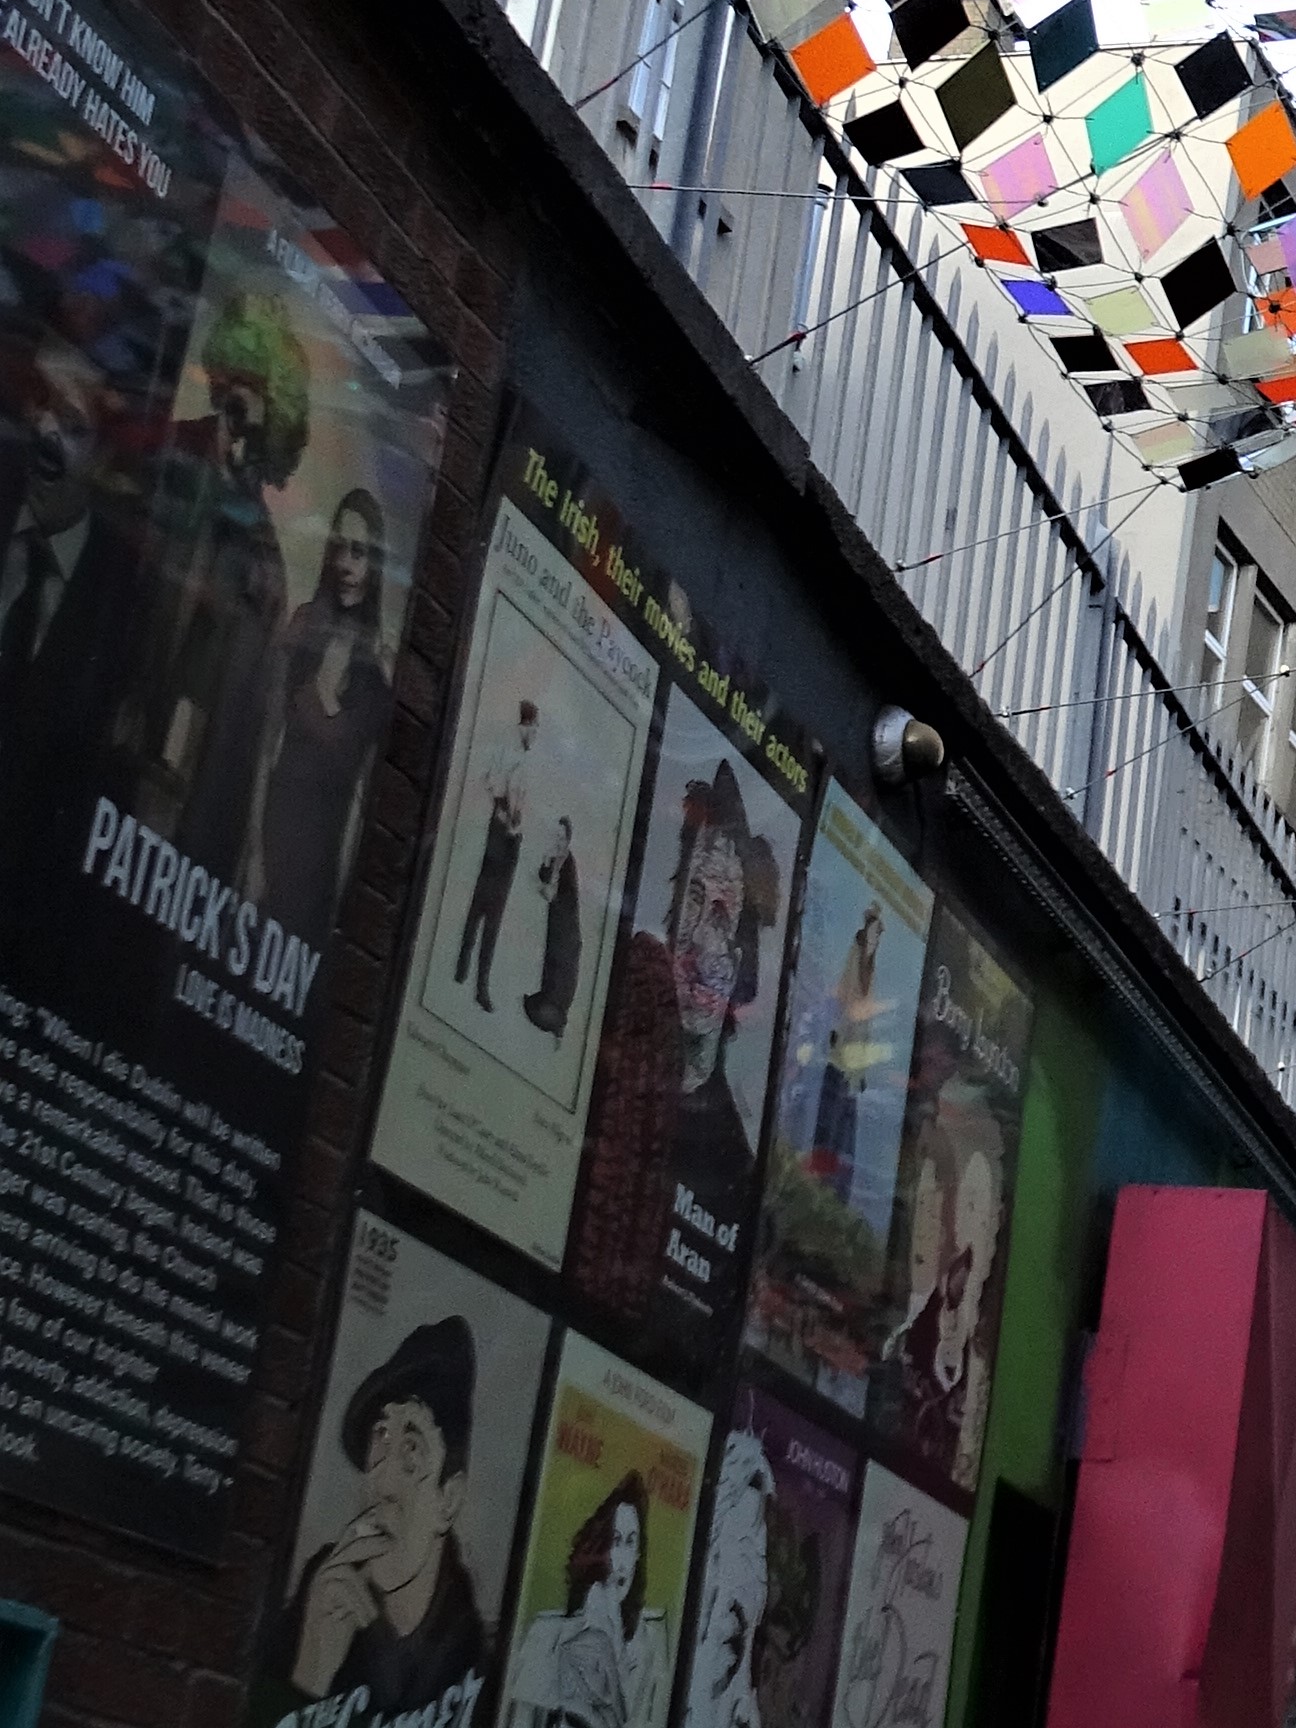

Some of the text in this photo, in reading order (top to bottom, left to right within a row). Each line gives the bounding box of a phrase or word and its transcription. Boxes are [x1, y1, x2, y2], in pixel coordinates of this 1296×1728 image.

[2, 7, 173, 200] ALREADY HATES YOU
[68, 13, 124, 91] KNOW
[119, 67, 156, 127] HIM
[493, 513, 653, 700] Juno and the Paycock
[522, 447, 808, 794] The Irish, their movies and their actors
[82, 795, 321, 1019] PATRICK'S DAY
[174, 962, 306, 1076] LOVE IS MADNESS
[666, 1227, 712, 1284] Aran
[674, 1182, 741, 1254] Man of
